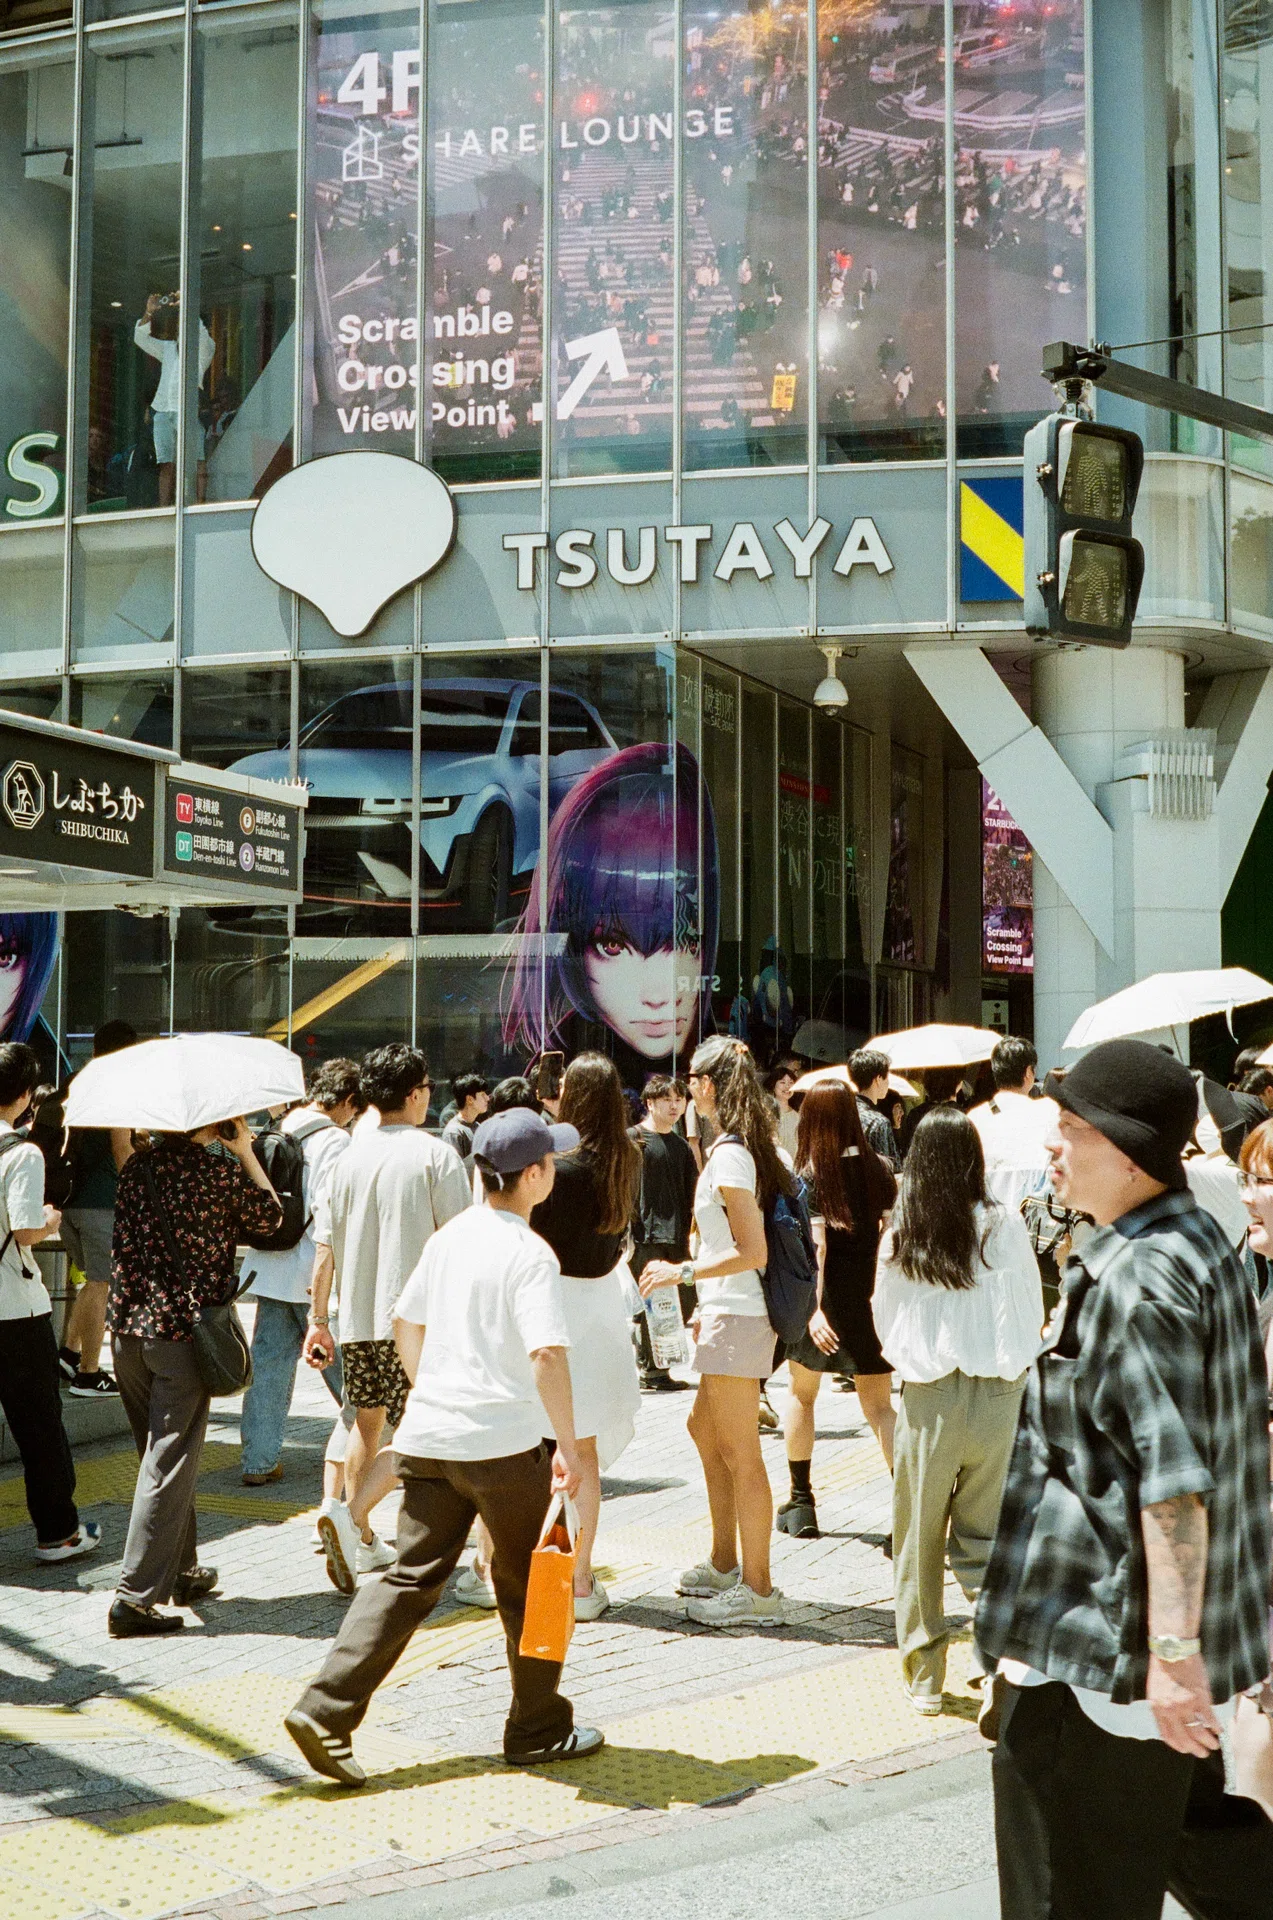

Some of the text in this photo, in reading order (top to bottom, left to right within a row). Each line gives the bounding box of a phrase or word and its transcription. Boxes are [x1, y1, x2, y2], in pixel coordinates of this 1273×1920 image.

[337, 50, 420, 115] 4F
[401, 107, 734, 161] SHARE LOUNGE
[338, 305, 514, 344] Scramble
[338, 352, 515, 391] Crossing
[337, 399, 511, 434] View Point
[5, 432, 59, 517] S
[503, 515, 896, 591] TSUTAYA
[52, 770, 145, 822] しぶちか
[987, 786, 1006, 811] 2
[179, 801, 191, 815] TY
[194, 797, 220, 815] 東横線
[194, 813, 224, 828] Toyoko Line
[255, 809, 286, 829] 副都心線
[984, 817, 1022, 830] STARBUC
[61, 820, 130, 845] SHIBUCHIKA
[255, 825, 290, 841] Fukutoshin Line
[178, 839, 190, 853] DT
[193, 834, 235, 855] 田園都市線
[193, 850, 237, 868] Den-en-toshi Line
[255, 845, 285, 864] 半蔵門線
[255, 861, 290, 877] Hanzomon Line
[986, 926, 1022, 938] Scramble
[986, 940, 1023, 955] Crossing
[986, 954, 1022, 965] View Point
[97, 1380, 110, 1390] N
